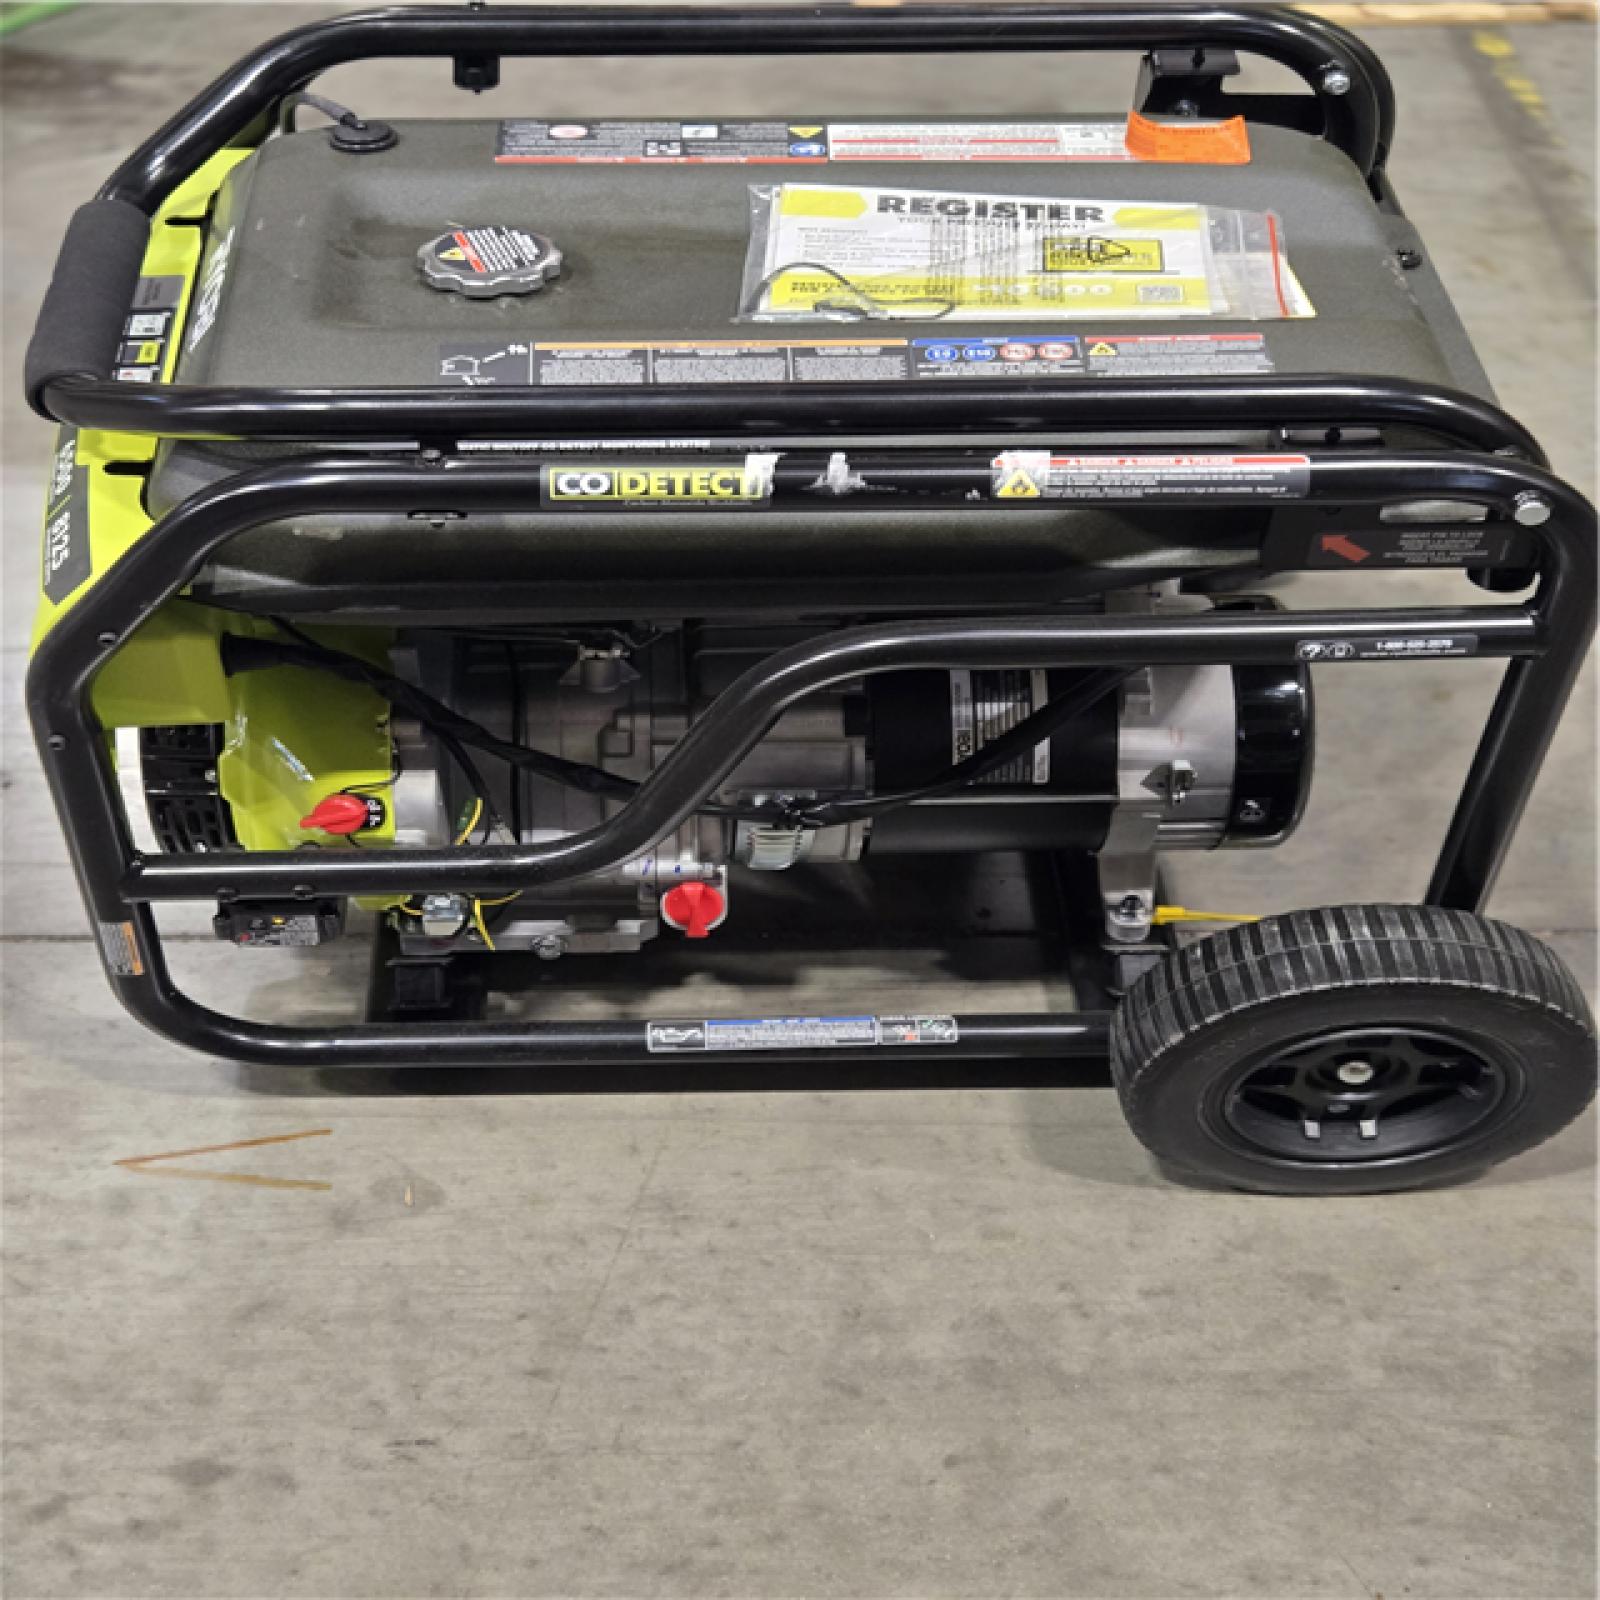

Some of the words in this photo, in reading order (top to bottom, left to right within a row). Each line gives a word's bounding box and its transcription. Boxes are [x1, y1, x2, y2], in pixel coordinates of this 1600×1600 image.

[877, 194, 1105, 222] REGISTER
[556, 471, 612, 496] CO
[622, 471, 757, 496] DETECT
